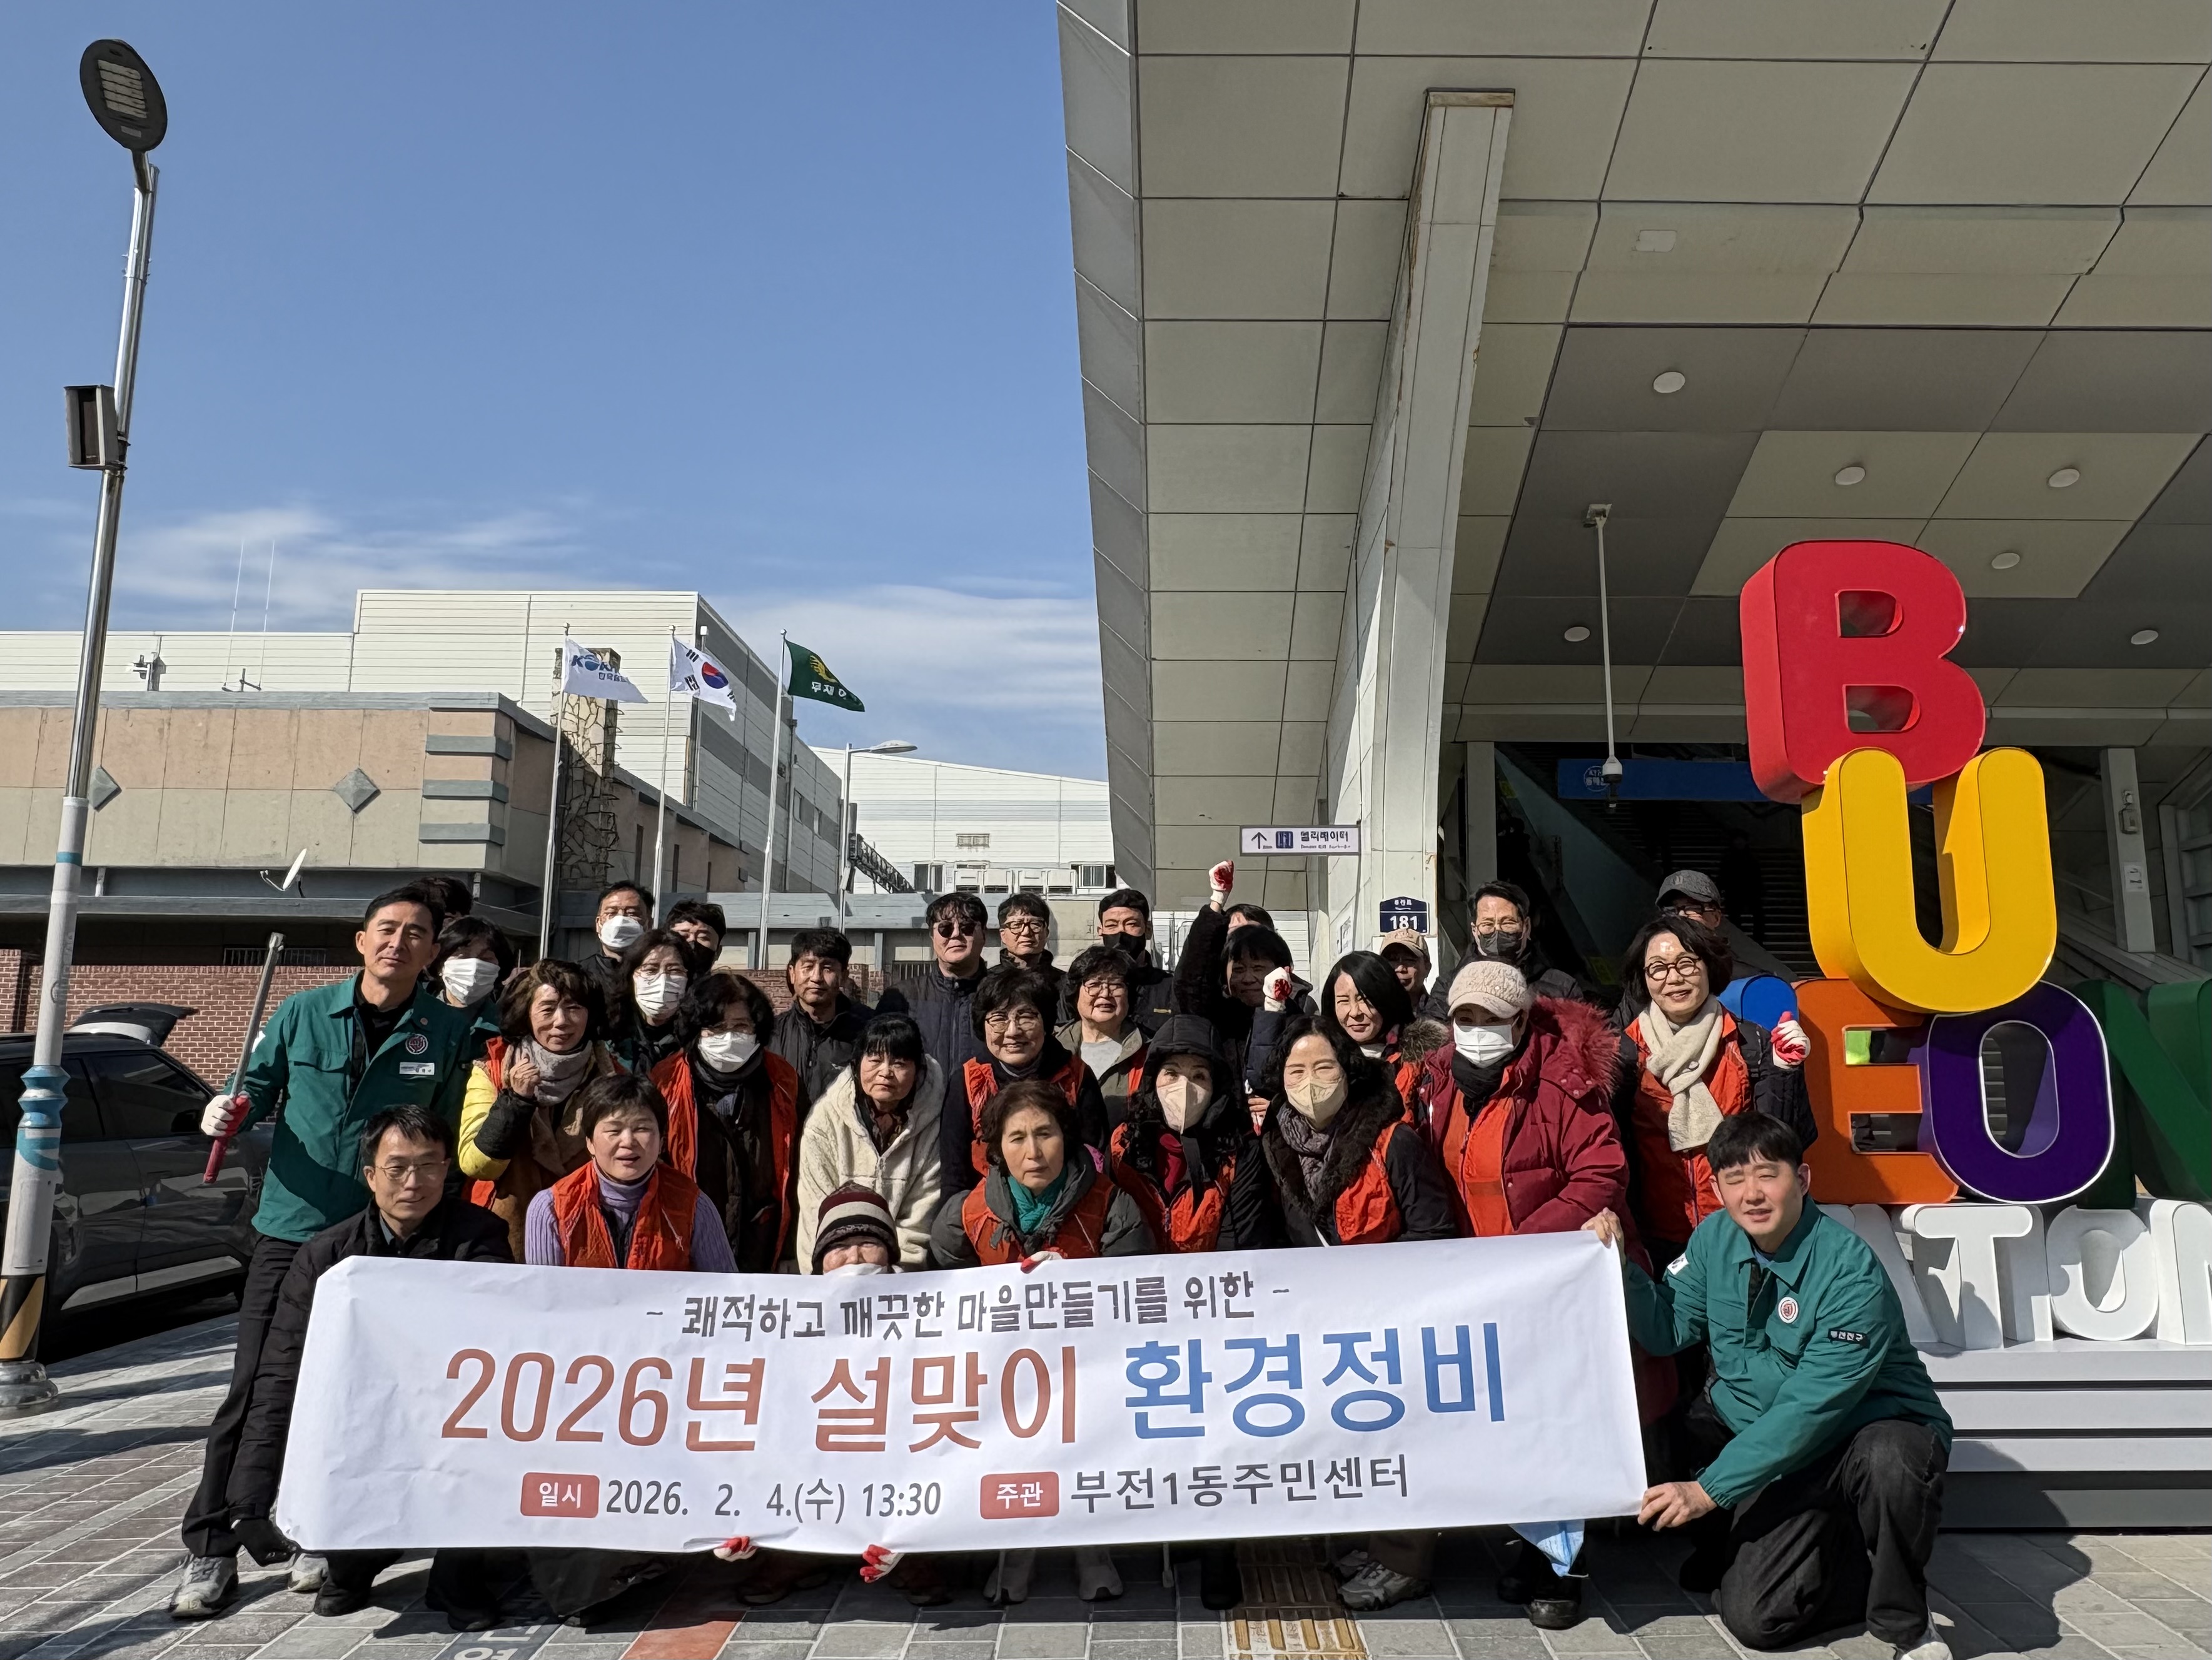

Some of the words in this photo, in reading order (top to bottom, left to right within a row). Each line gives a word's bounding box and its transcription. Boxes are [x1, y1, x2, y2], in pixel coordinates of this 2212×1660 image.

[1390, 915, 1418, 930] 181
[681, 1294, 826, 1342] 쾌적하고
[839, 1290, 944, 1340] 깨끗한
[957, 1275, 1168, 1332] 마을만들기를
[1183, 1270, 1255, 1319] 위한
[441, 1348, 765, 1452] 2026년
[811, 1346, 1076, 1453] 설맞이
[1125, 1322, 1505, 1439] 환경정비
[538, 1481, 582, 1509] 일시
[606, 1479, 689, 1515] 2026.
[715, 1483, 740, 1516] 2.
[766, 1477, 845, 1524] 4.(수)
[862, 1482, 941, 1517] 13:30
[996, 1481, 1044, 1509] 주관
[1071, 1453, 1408, 1513] 부전1동주민센터
